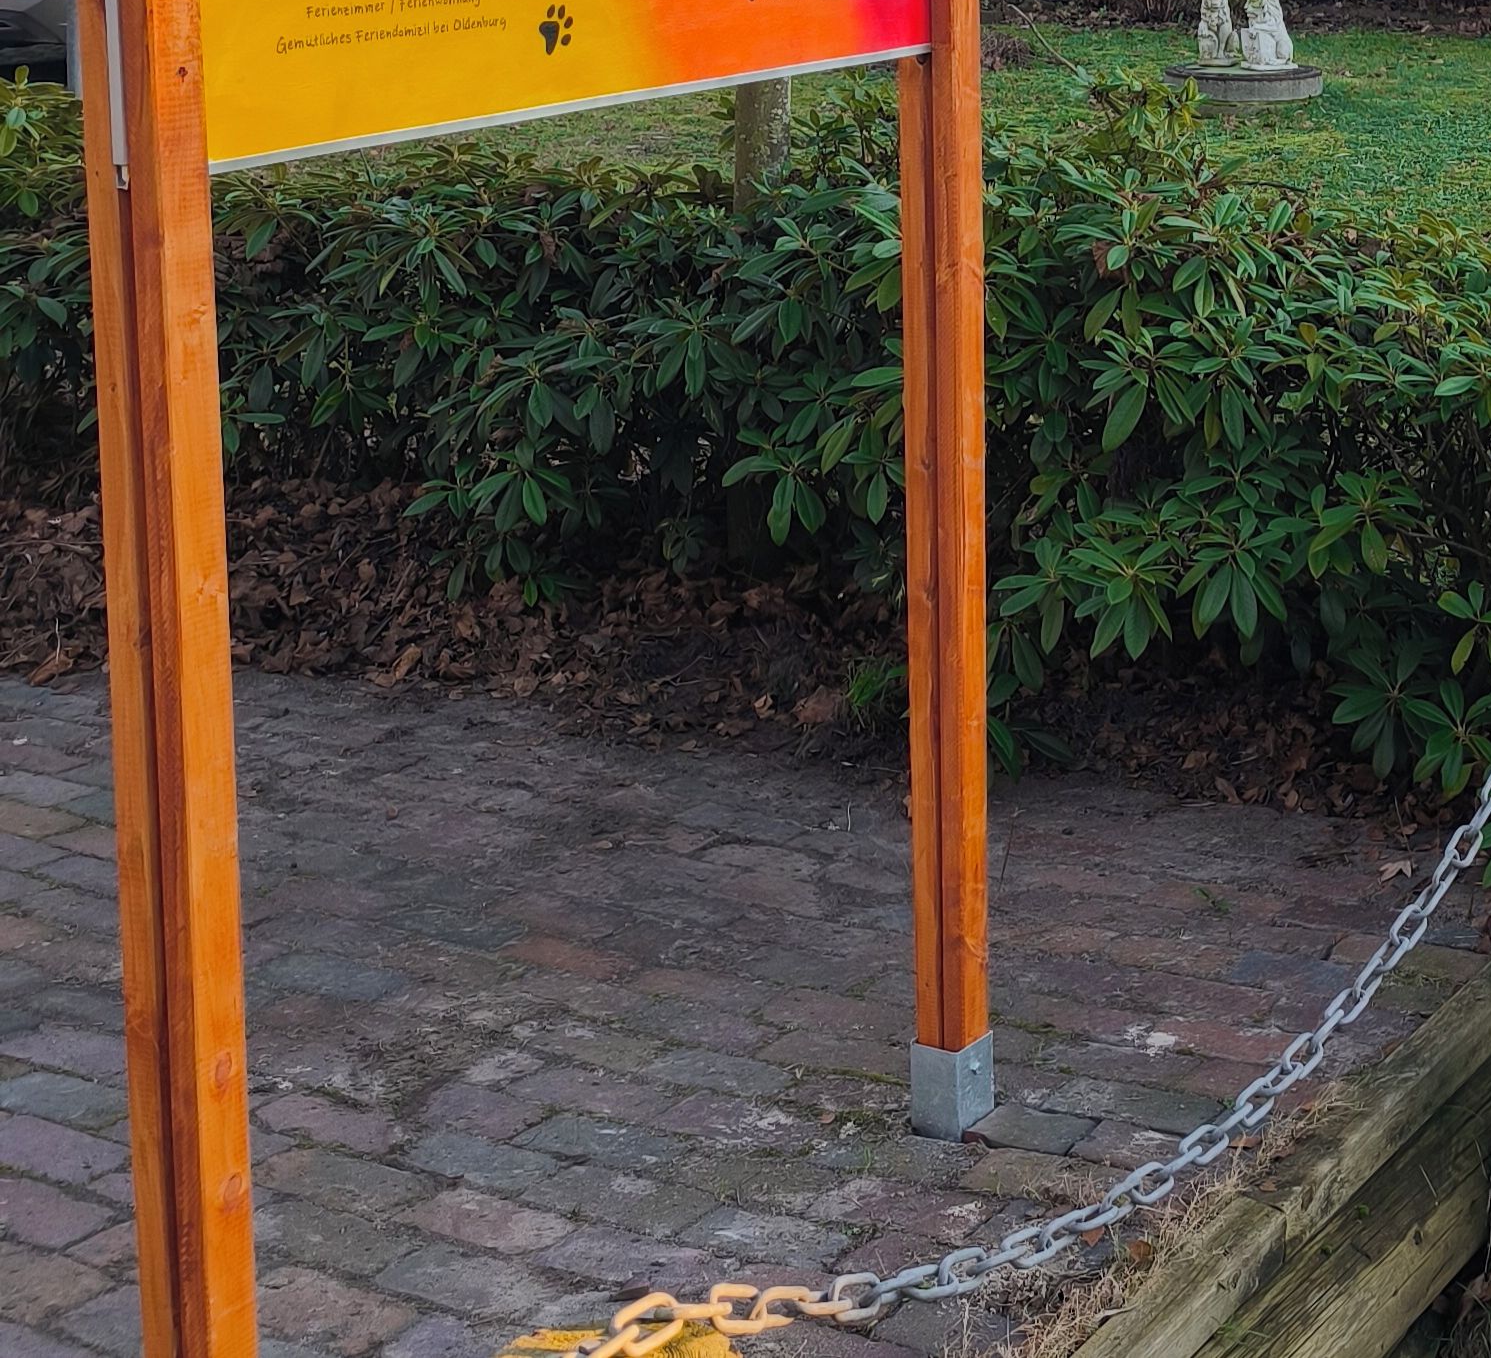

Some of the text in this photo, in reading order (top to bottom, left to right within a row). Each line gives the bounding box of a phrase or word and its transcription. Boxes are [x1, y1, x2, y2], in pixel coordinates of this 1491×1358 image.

[306, 0, 385, 18] Ferienzimmer
[355, 22, 430, 42] Feriendomizil
[433, 20, 449, 33] bei
[453, 15, 507, 31] Oldenburg
